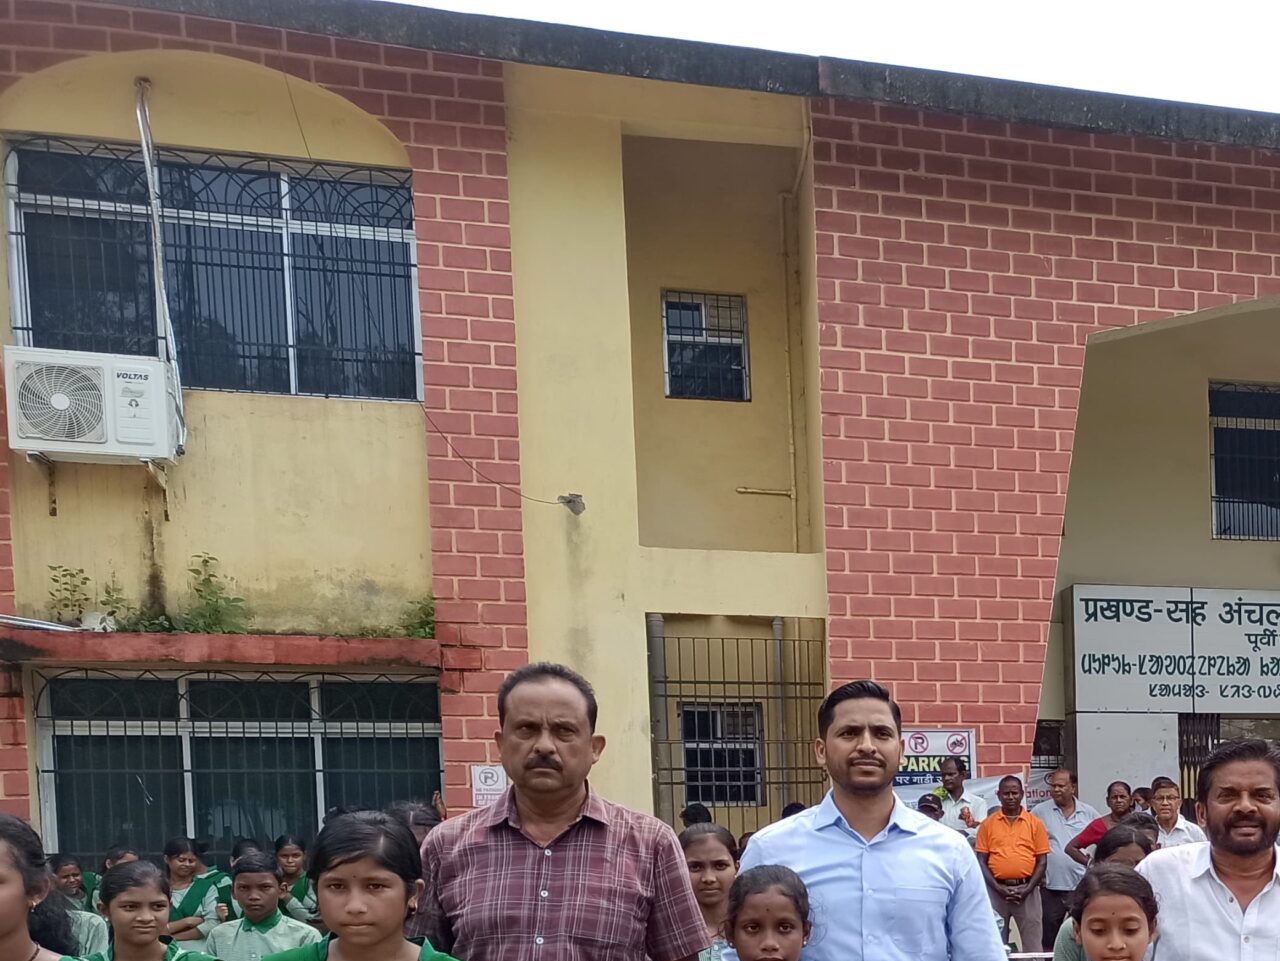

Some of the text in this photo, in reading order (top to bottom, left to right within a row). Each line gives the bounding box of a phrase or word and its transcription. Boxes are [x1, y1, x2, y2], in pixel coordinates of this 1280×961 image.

[116, 371, 149, 381] VOLTAS
[1080, 598, 1207, 626] प्रखण्ड-सह
[1245, 629, 1278, 652] पूर्वी
[899, 757, 970, 772] PARKG
